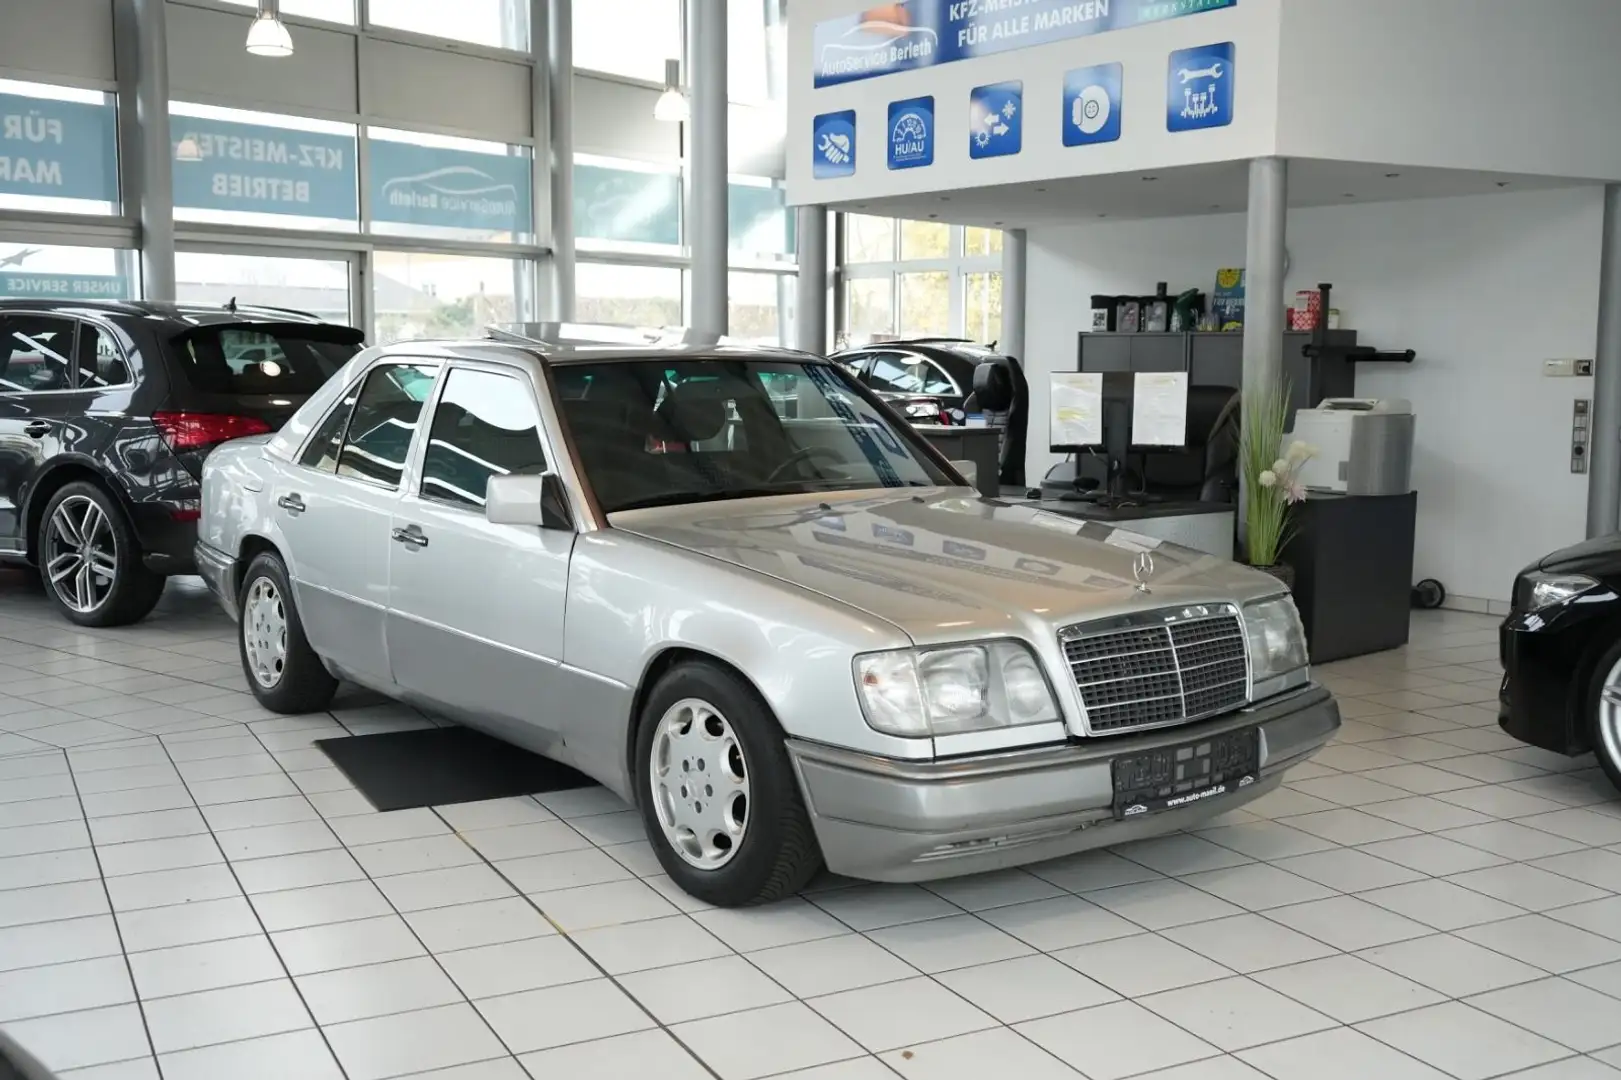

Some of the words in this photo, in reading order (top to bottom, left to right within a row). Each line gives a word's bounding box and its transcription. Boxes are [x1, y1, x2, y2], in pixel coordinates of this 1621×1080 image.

[957, 22, 988, 47] FÜR
[991, 16, 1030, 41] ALLE
[1034, 0, 1109, 31] MARKEN
[821, 51, 888, 77] AutoService
[890, 38, 932, 62] Berleth
[895, 139, 925, 156] HU/AU
